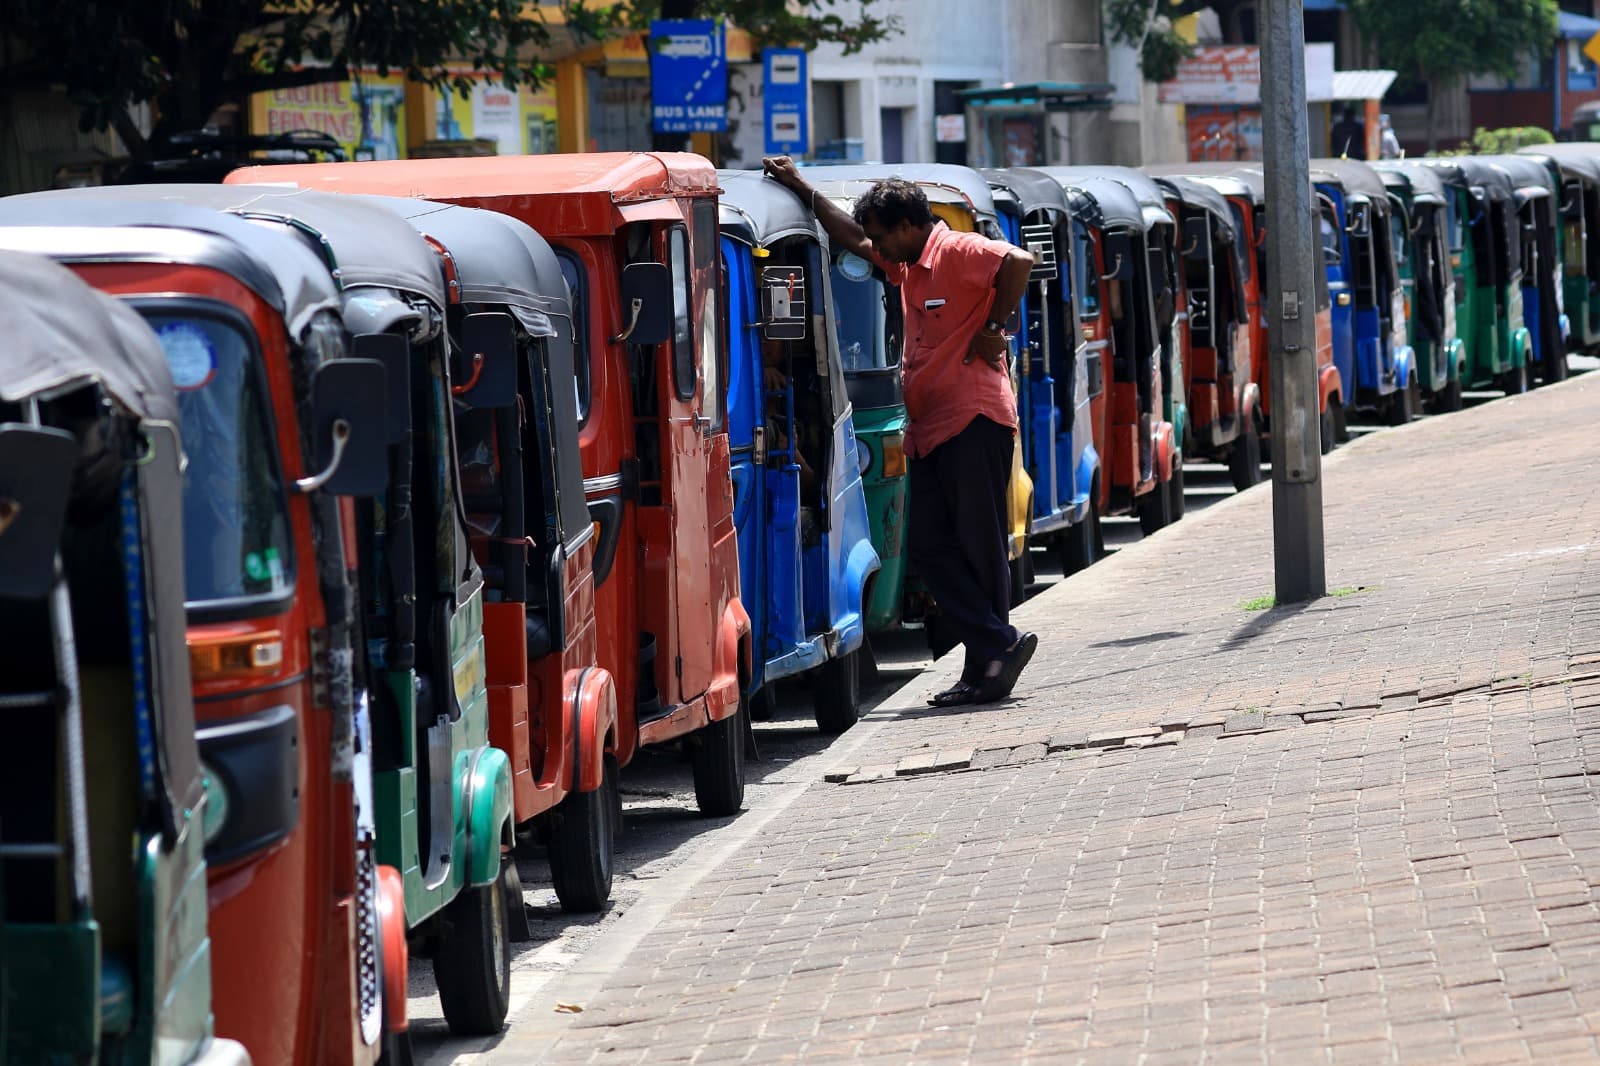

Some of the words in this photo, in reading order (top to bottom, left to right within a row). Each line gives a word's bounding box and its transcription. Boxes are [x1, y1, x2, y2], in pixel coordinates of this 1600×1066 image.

[272, 81, 347, 106] DIGITAL
[655, 106, 683, 118] BUS
[688, 106, 724, 118] LANE
[267, 108, 357, 142] PRINTING
